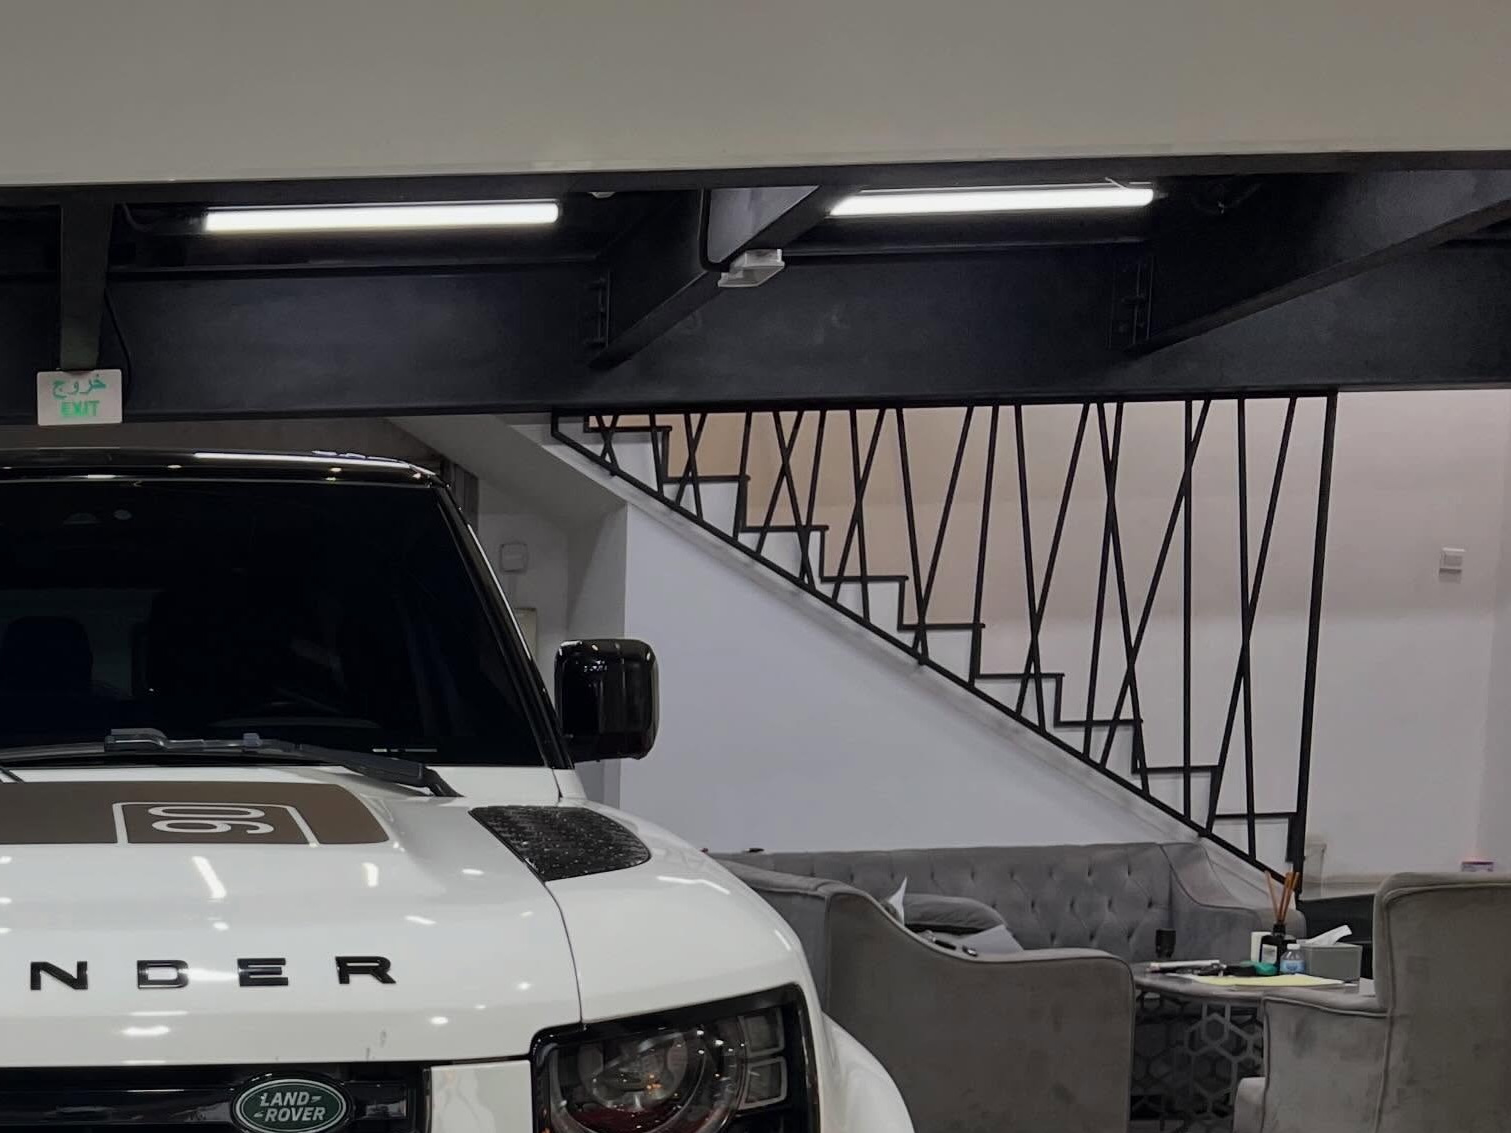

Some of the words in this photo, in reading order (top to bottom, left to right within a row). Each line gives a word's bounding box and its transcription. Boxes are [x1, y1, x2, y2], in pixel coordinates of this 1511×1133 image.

[52, 374, 106, 398] خروج
[60, 401, 100, 417] EXIT
[147, 806, 274, 834] 90
